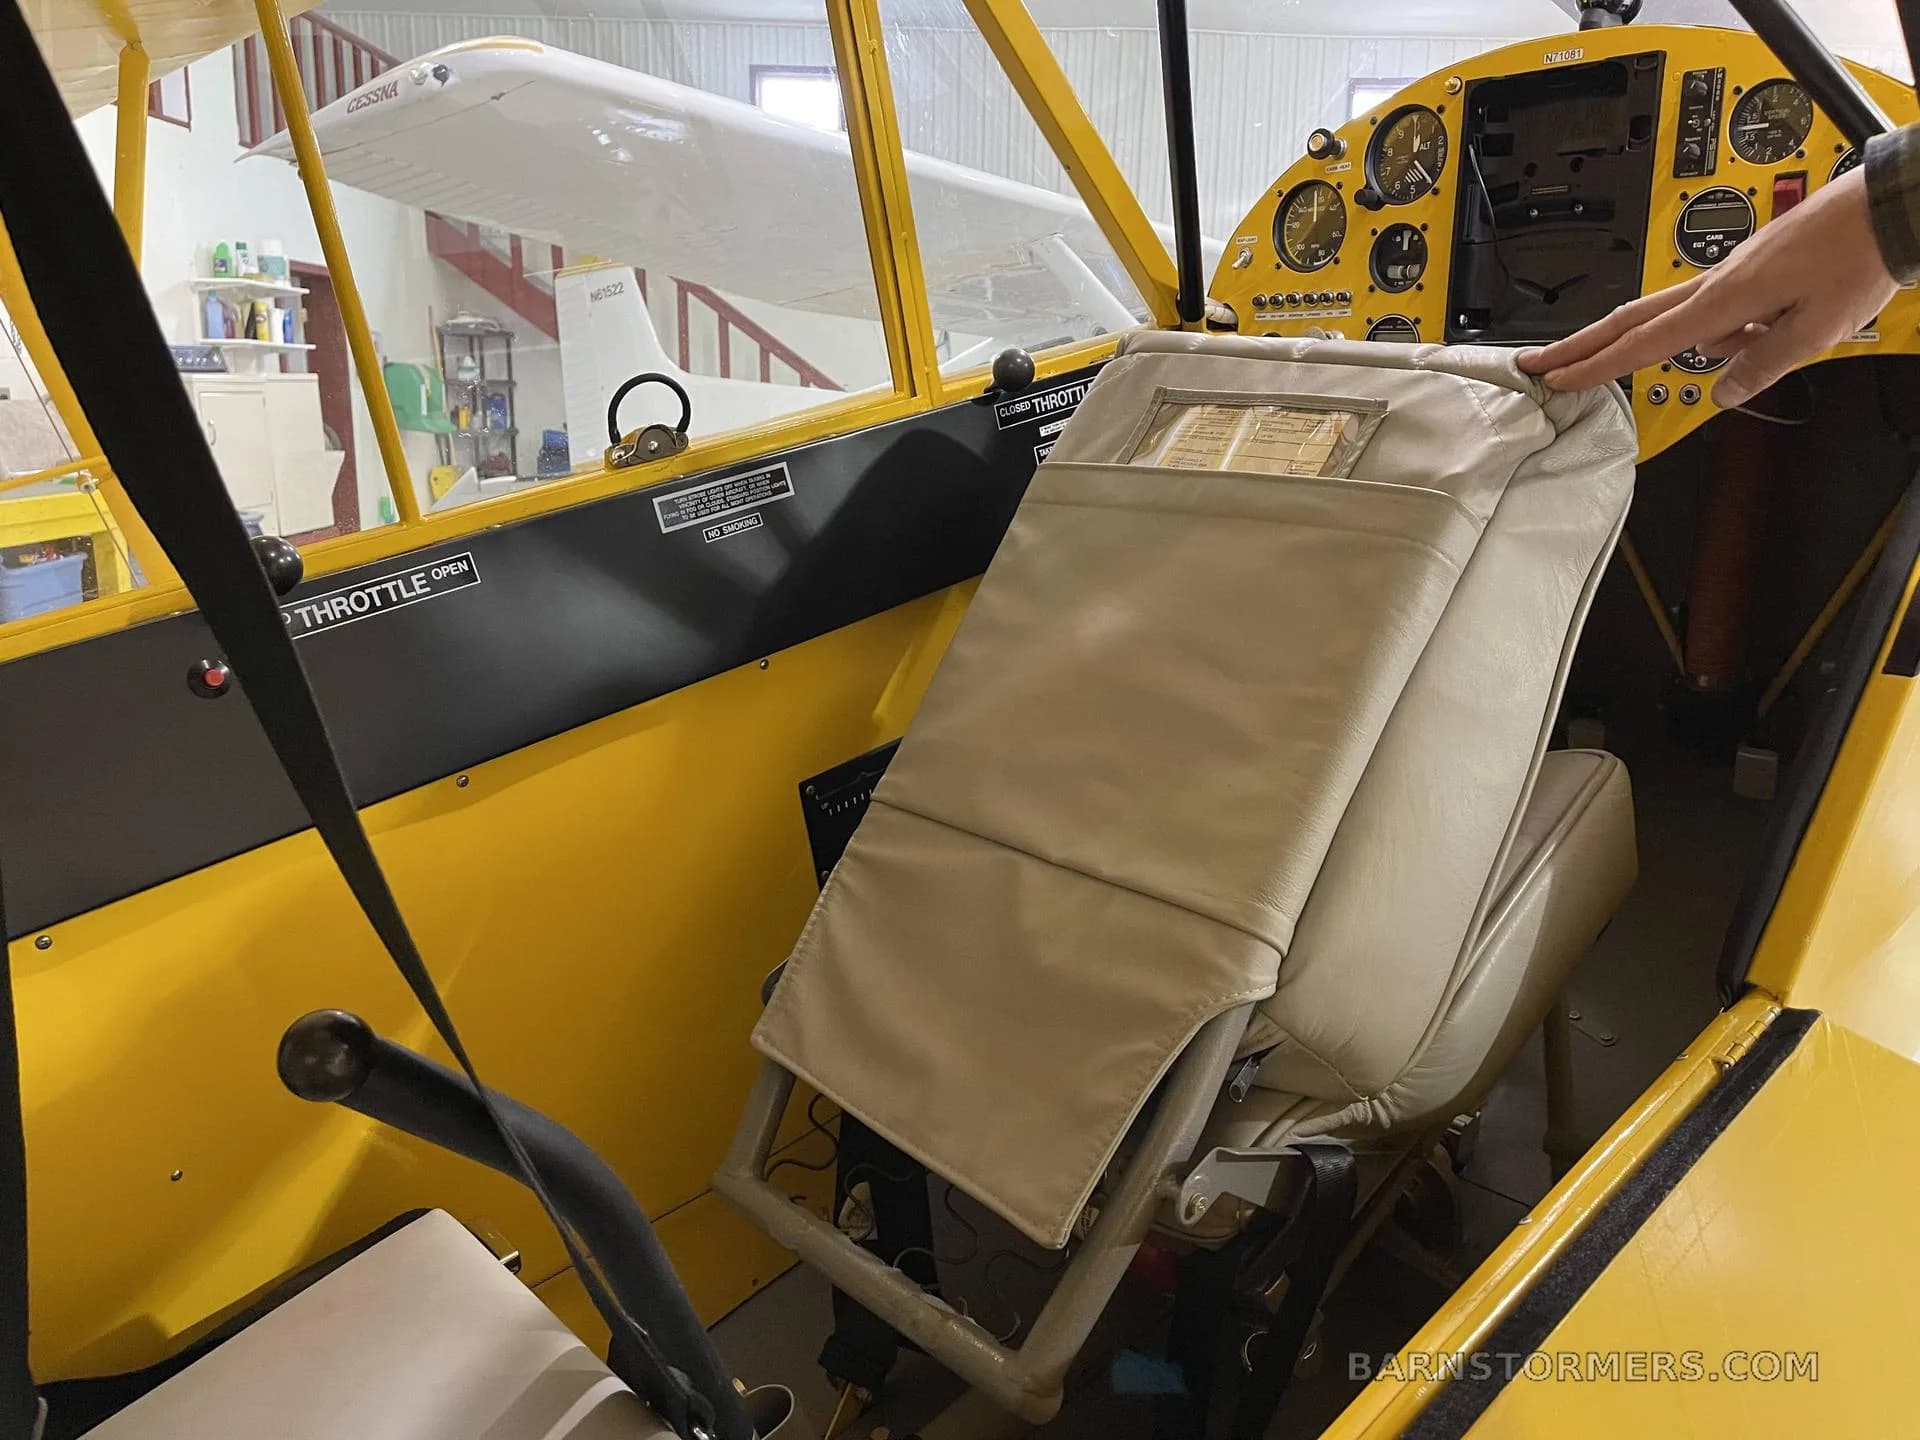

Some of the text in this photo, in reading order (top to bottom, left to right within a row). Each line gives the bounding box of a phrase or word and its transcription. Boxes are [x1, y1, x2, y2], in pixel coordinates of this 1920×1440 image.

[1545, 50, 1581, 63] N71081
[347, 80, 399, 114] CESSNA
[1398, 130, 1405, 139] 9
[1438, 135, 1445, 145] 2
[1419, 141, 1432, 151] ALT
[1386, 147, 1394, 157] 8
[1385, 166, 1392, 176] 7
[1394, 180, 1402, 190] 6
[1409, 185, 1416, 194] 5
[1692, 241, 1706, 249] EGT
[590, 280, 625, 303] N61522
[999, 382, 1095, 418] CLOSED THROTTL
[708, 490, 725, 501] OTHER
[686, 505, 698, 514] FOG
[707, 516, 759, 539] NO SMOKING
[293, 559, 470, 628] THROTTLE OPEN
